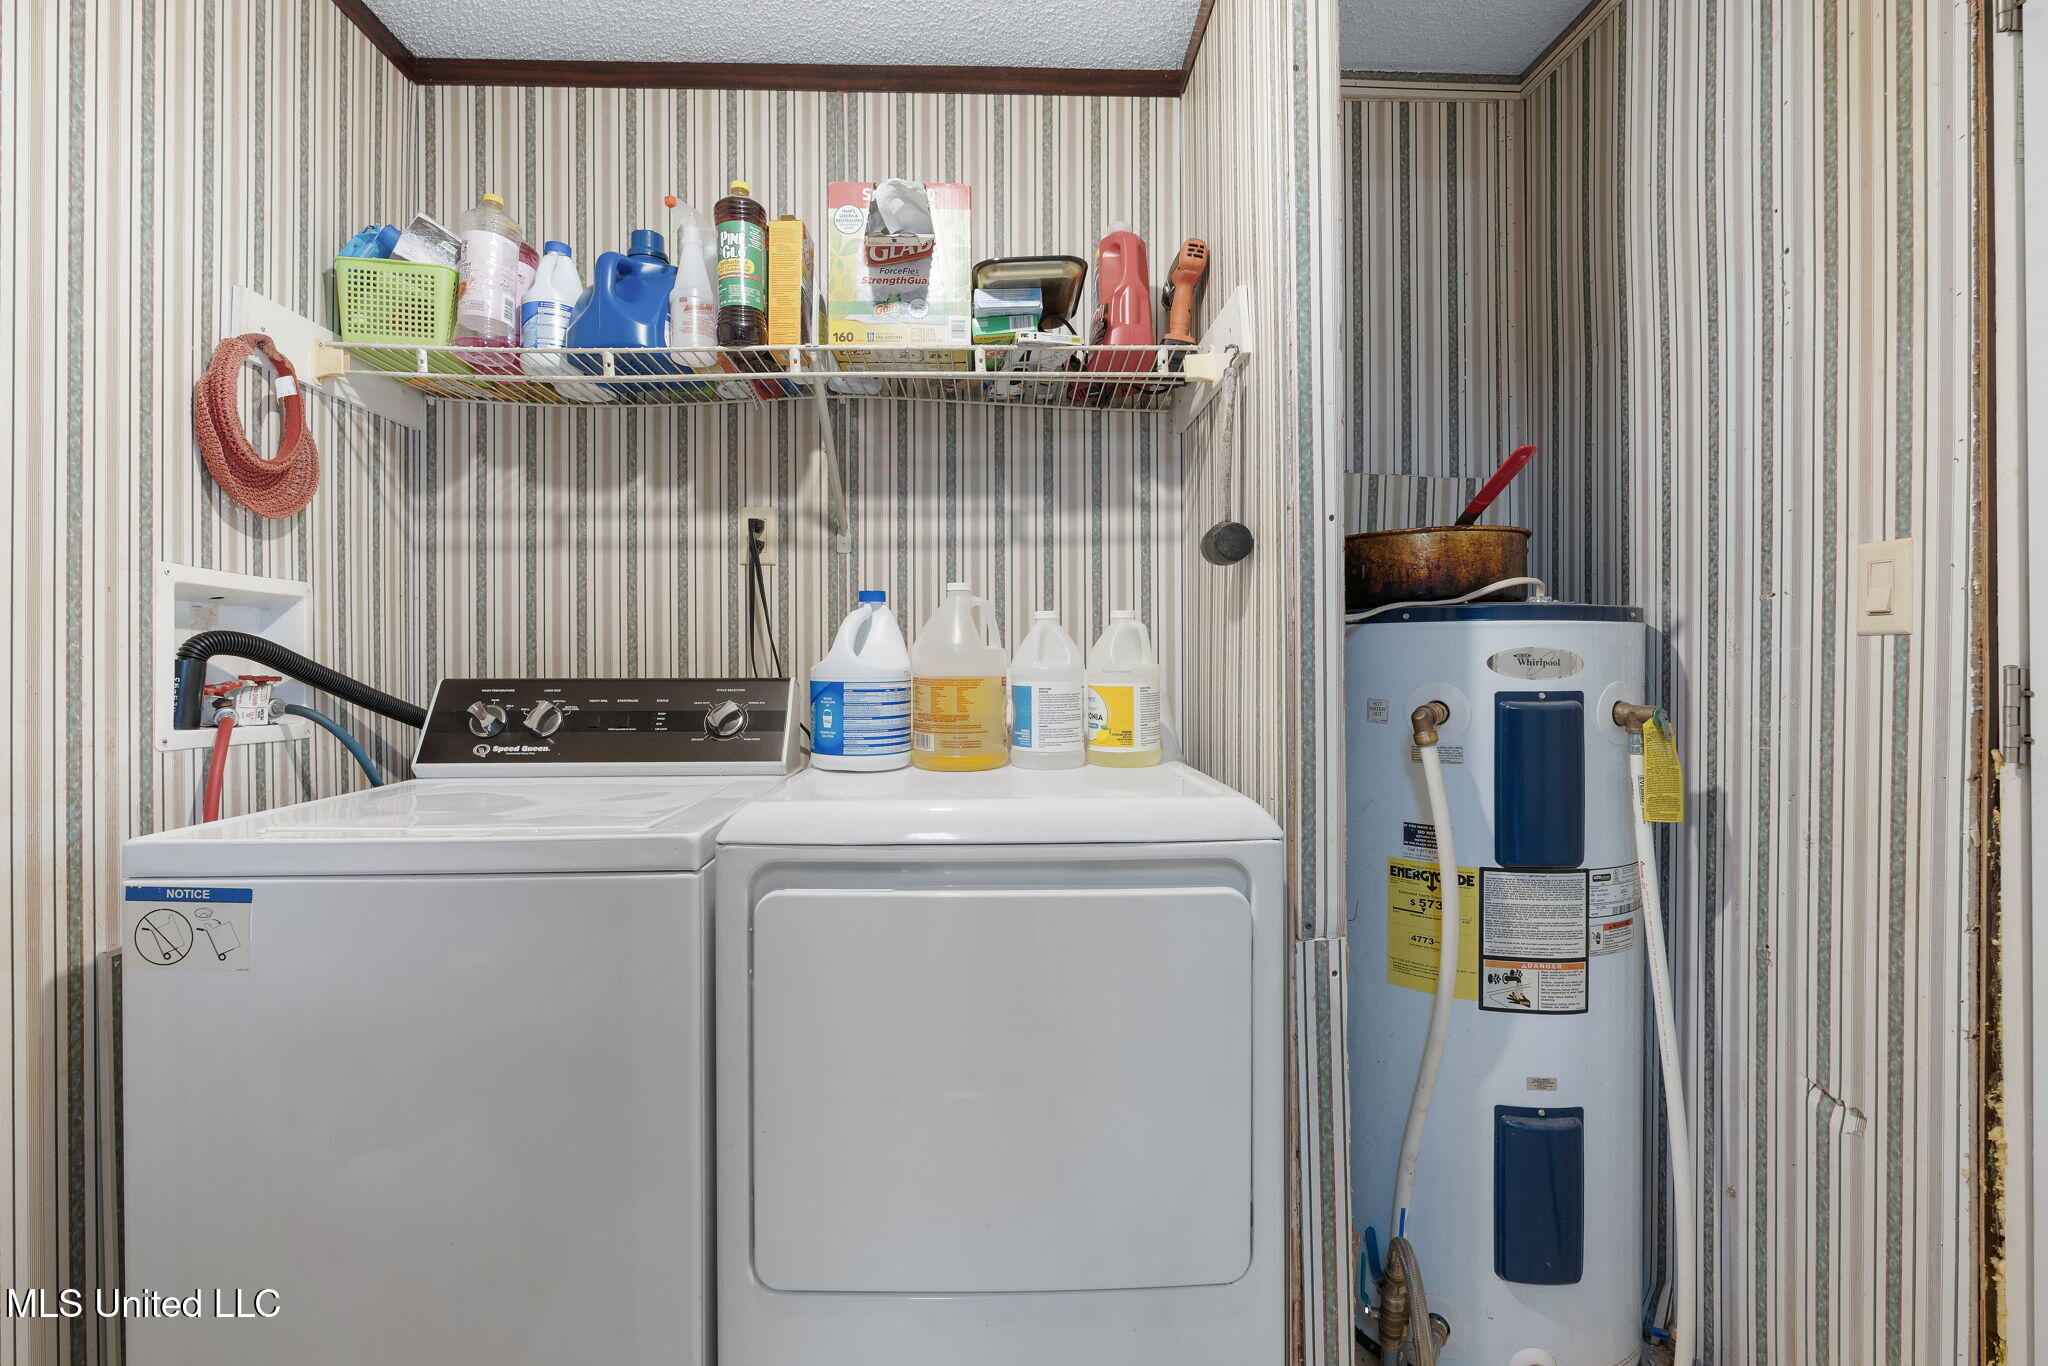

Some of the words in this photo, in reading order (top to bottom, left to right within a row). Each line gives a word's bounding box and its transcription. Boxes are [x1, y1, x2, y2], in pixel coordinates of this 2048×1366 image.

[720, 231, 746, 247] PINE
[869, 239, 932, 262] GLAD
[880, 267, 920, 275] ForceFlex
[861, 277, 929, 286] StrengthGua
[874, 303, 900, 316] Gain
[833, 332, 854, 342] 160
[1517, 658, 1561, 668] Whirlpool
[1088, 712, 1103, 721] ONIA
[492, 745, 520, 753] Speed
[1390, 865, 1475, 888] ENERGYGDE
[166, 889, 210, 899] NOTICE
[1419, 898, 1442, 910] 573
[1410, 934, 1434, 945] 4773
